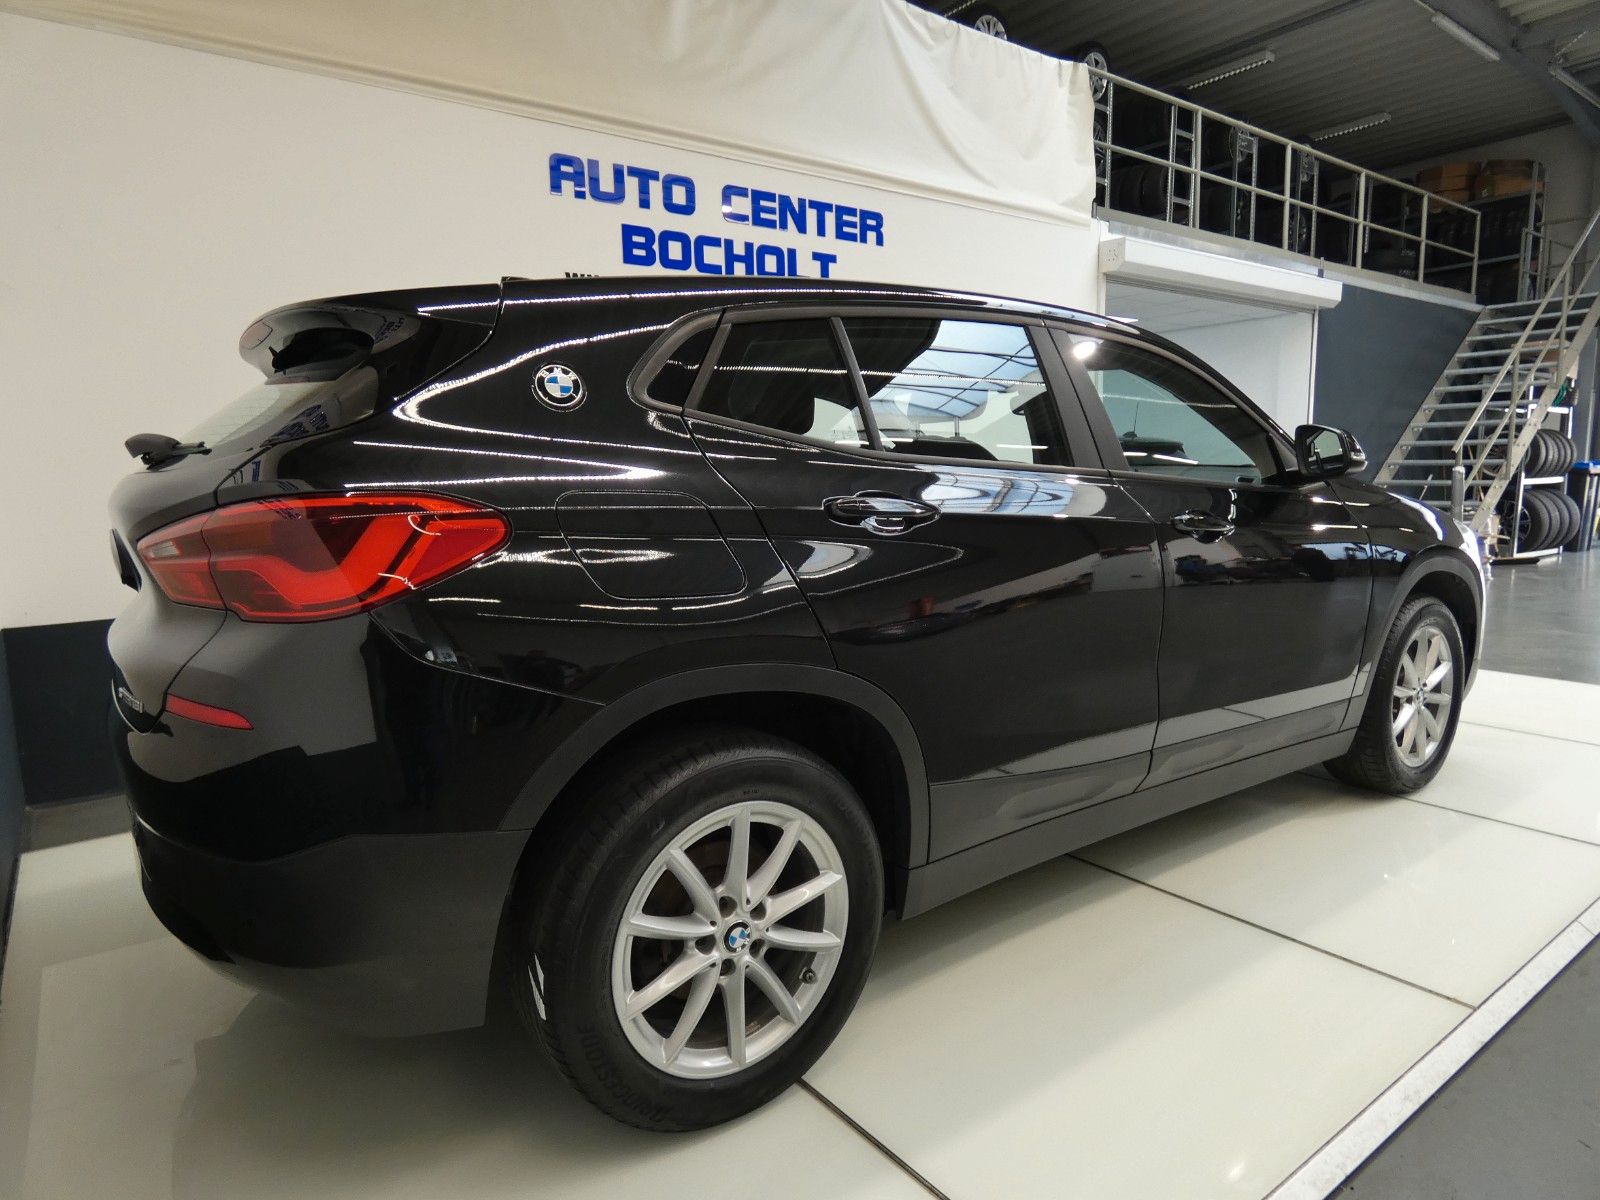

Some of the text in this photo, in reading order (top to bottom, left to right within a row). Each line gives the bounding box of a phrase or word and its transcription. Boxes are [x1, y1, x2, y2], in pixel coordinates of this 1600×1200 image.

[549, 152, 884, 247] AUTO CENTER
[621, 223, 838, 279] BOCHOLT
